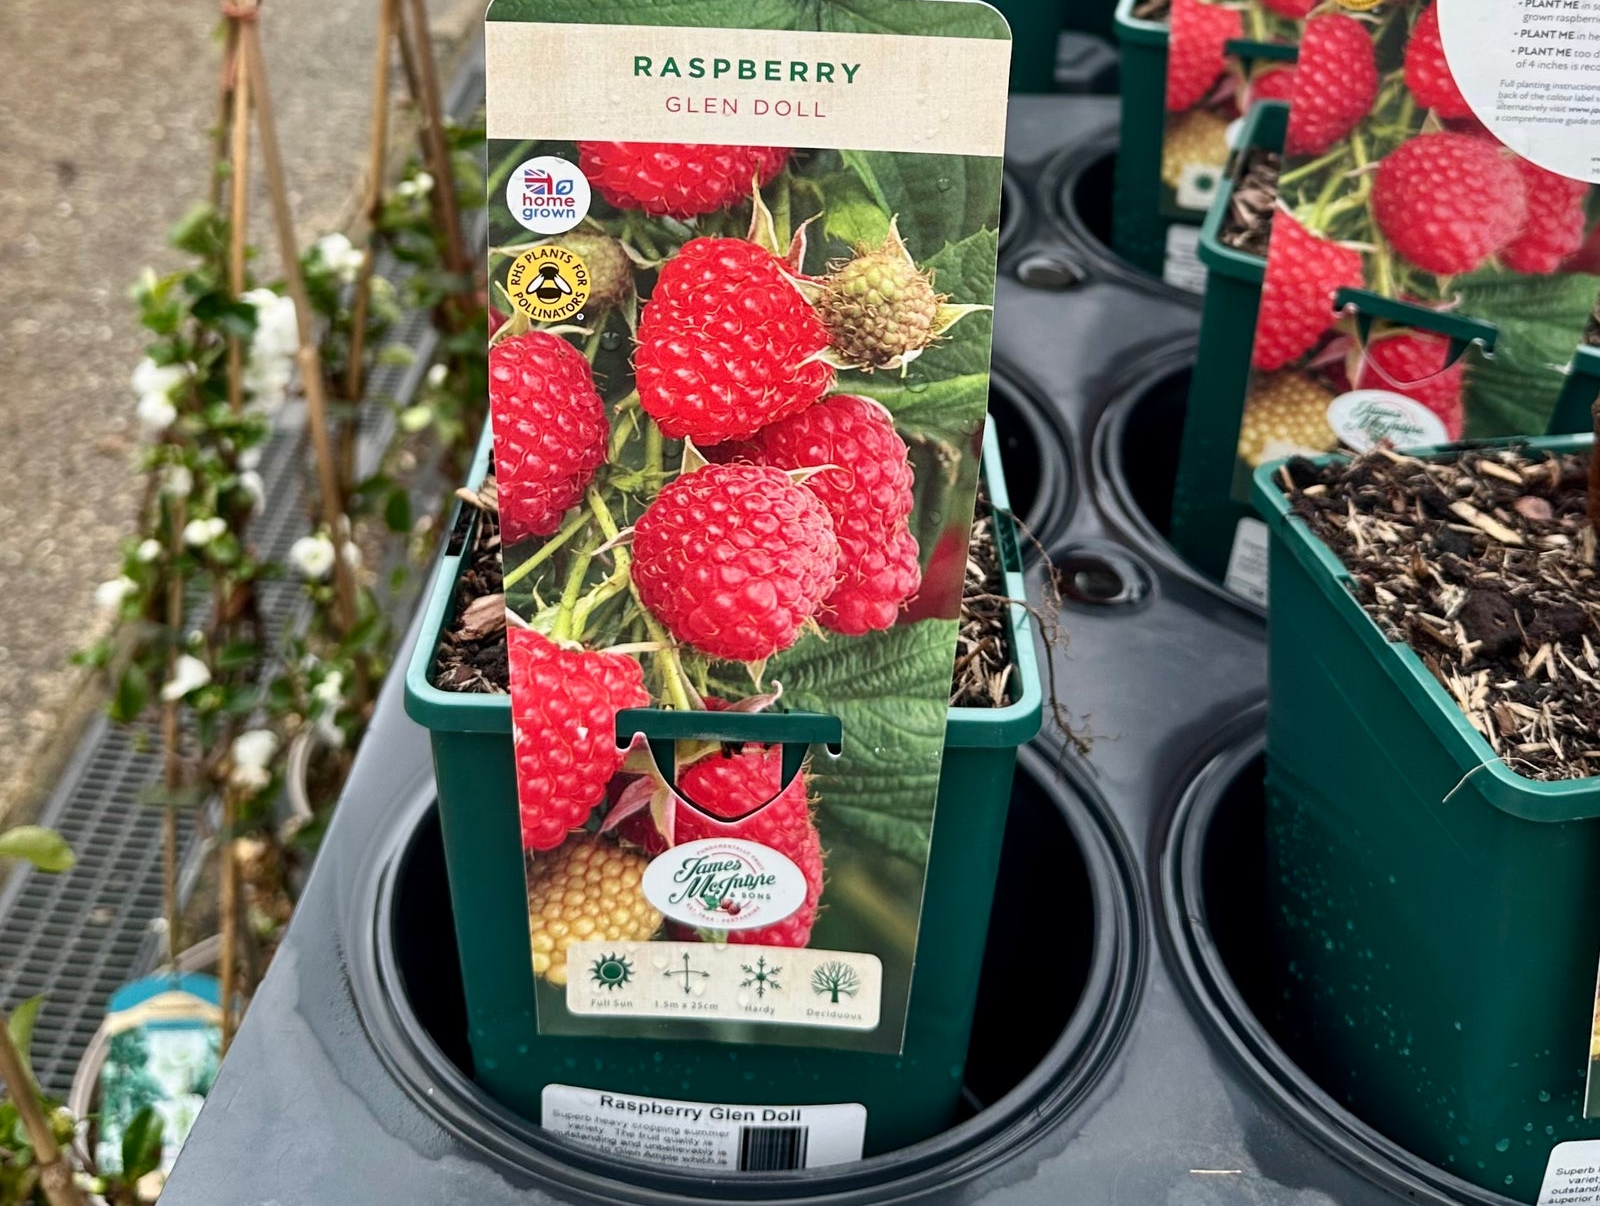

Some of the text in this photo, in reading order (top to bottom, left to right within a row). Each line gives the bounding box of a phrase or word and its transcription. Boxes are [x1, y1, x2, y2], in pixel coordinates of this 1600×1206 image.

[1525, 0, 1561, 8] PLANT
[1563, 1, 1579, 9] ME
[1522, 13, 1553, 23] grown
[1520, 29, 1557, 38] PLANT
[1558, 31, 1575, 40] ME
[1518, 46, 1554, 55] PLANT
[1556, 48, 1572, 57] ME
[633, 55, 861, 84] RASPBERRY
[1516, 59, 1527, 68] of
[1528, 60, 1535, 68] 4
[1537, 61, 1568, 70] inches
[1571, 62, 1578, 70] is
[1516, 81, 1551, 91] planting
[1520, 92, 1529, 100] of
[1574, 94, 1594, 102] label
[665, 96, 826, 118] GLEN DOLL
[1496, 103, 1548, 113] alternatively
[1501, 115, 1563, 124] comprehensive
[1565, 117, 1589, 126] guide
[522, 193, 575, 207] home
[522, 208, 575, 220] grown
[511, 248, 587, 286] RHS PLANTS FOR
[513, 291, 586, 319] POLLINATORS
[674, 855, 742, 883] James
[669, 873, 776, 904] McIntyre
[742, 892, 771, 900] SONS
[591, 998, 633, 1008] Full Sun
[655, 1000, 678, 1009] 1.5m
[692, 1001, 719, 1010] 25cm
[745, 1004, 775, 1015] Hardy
[806, 1008, 862, 1020] Deciduous
[600, 1095, 801, 1122] Raspberry Glen Doll
[552, 1109, 730, 1138] Superb heavy cropping summer
[615, 1128, 635, 1138] The
[638, 1131, 661, 1142] fruit
[663, 1135, 700, 1146] quality
[621, 1138, 641, 1148] and
[644, 1141, 713, 1156] unbelievably
[717, 1148, 727, 1157] is
[644, 1150, 679, 1162] Ample
[1556, 1166, 1595, 1176] Superb
[1548, 1195, 1593, 1205] superior
